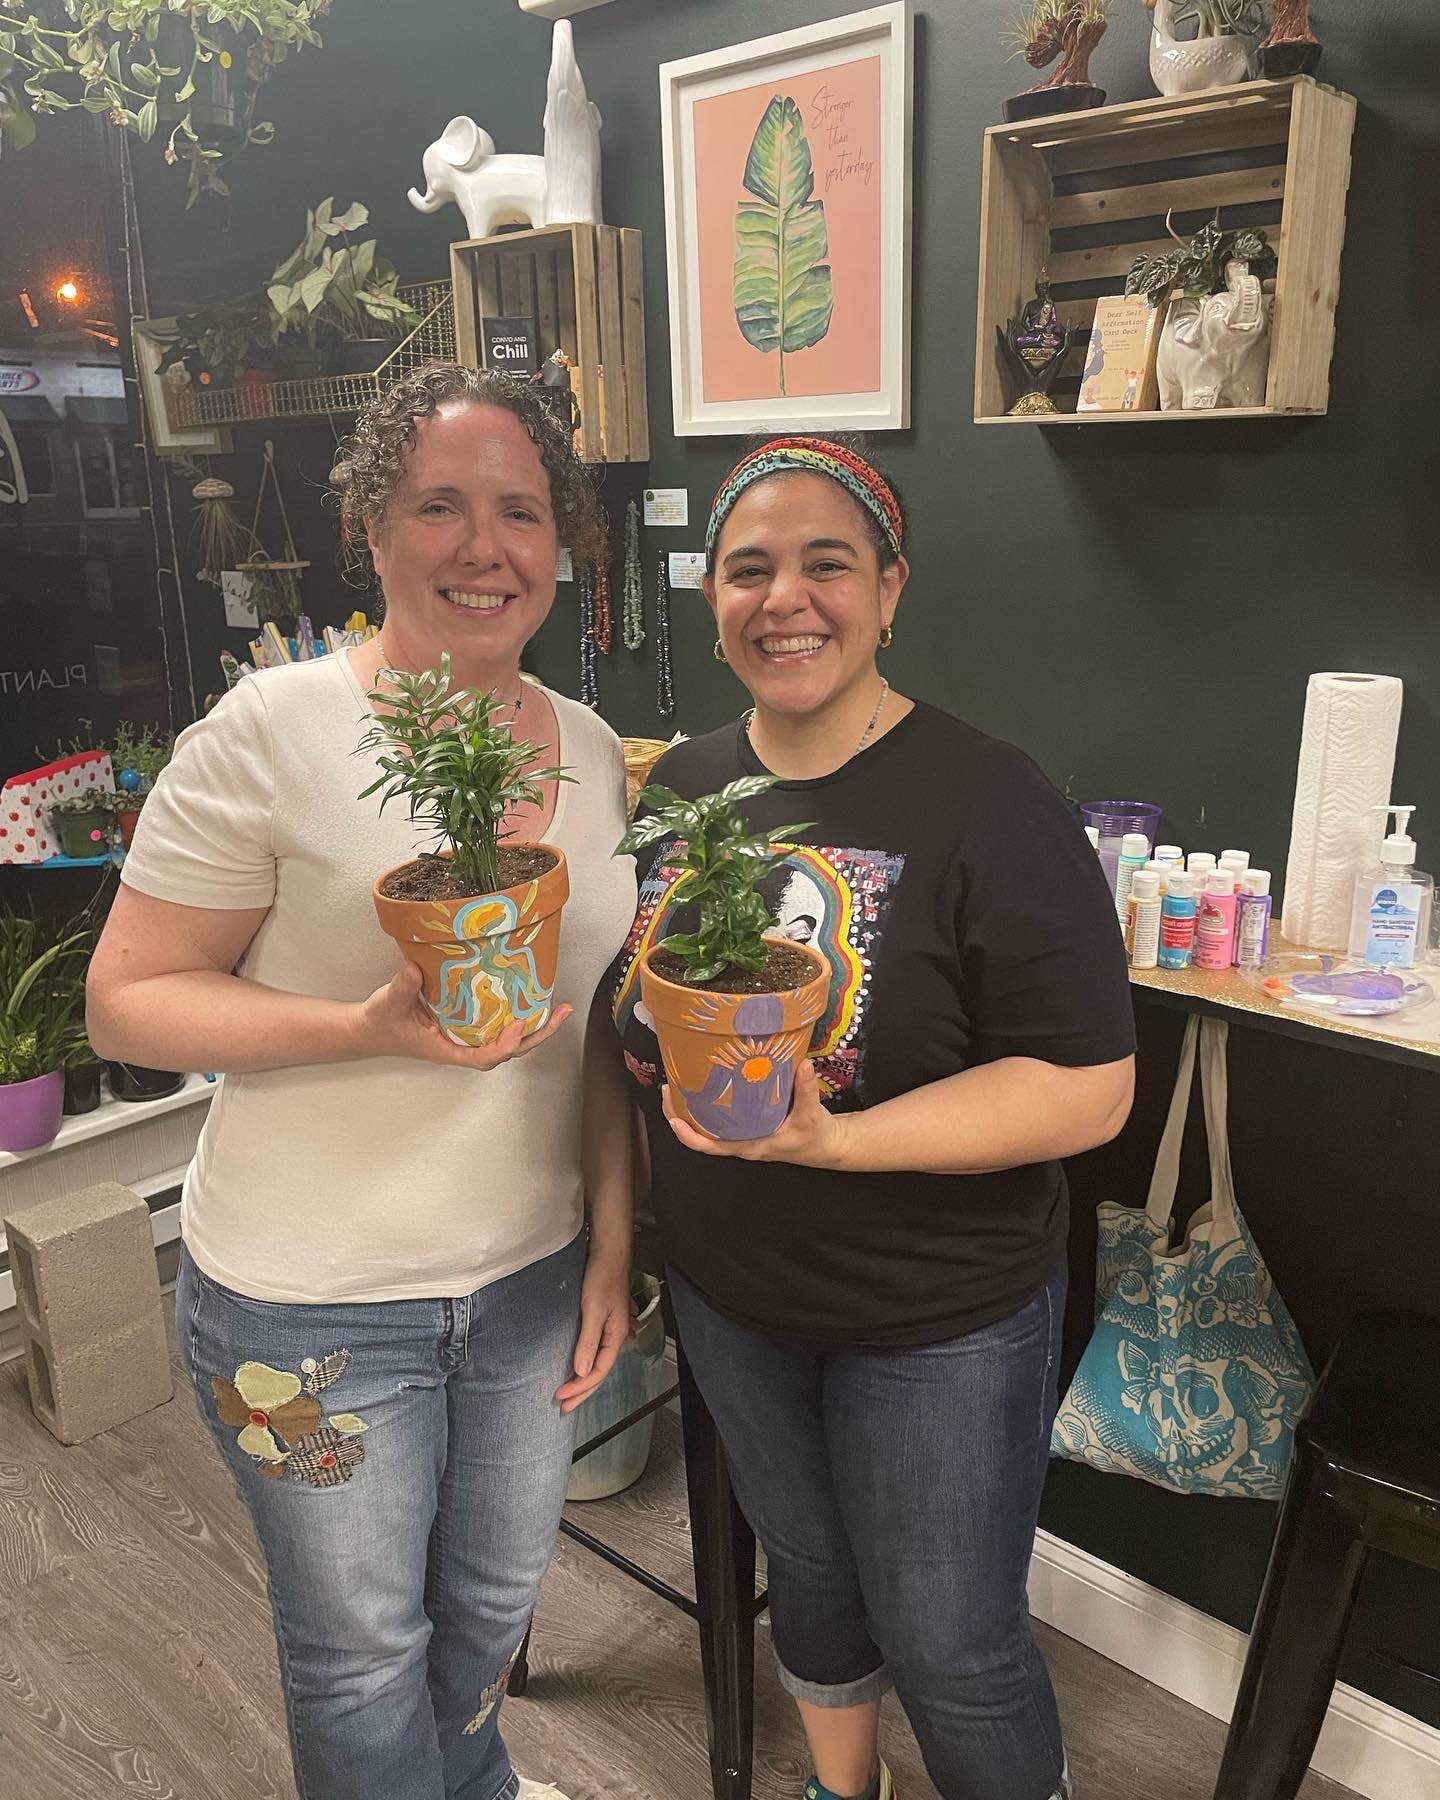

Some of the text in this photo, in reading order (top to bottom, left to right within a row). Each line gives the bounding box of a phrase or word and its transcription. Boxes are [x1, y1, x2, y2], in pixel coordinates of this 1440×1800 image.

[824, 146, 873, 192] yesterday
[1107, 309, 1142, 319] Dear Self
[1122, 328, 1138, 336] Deck
[492, 343, 529, 360] Chill
